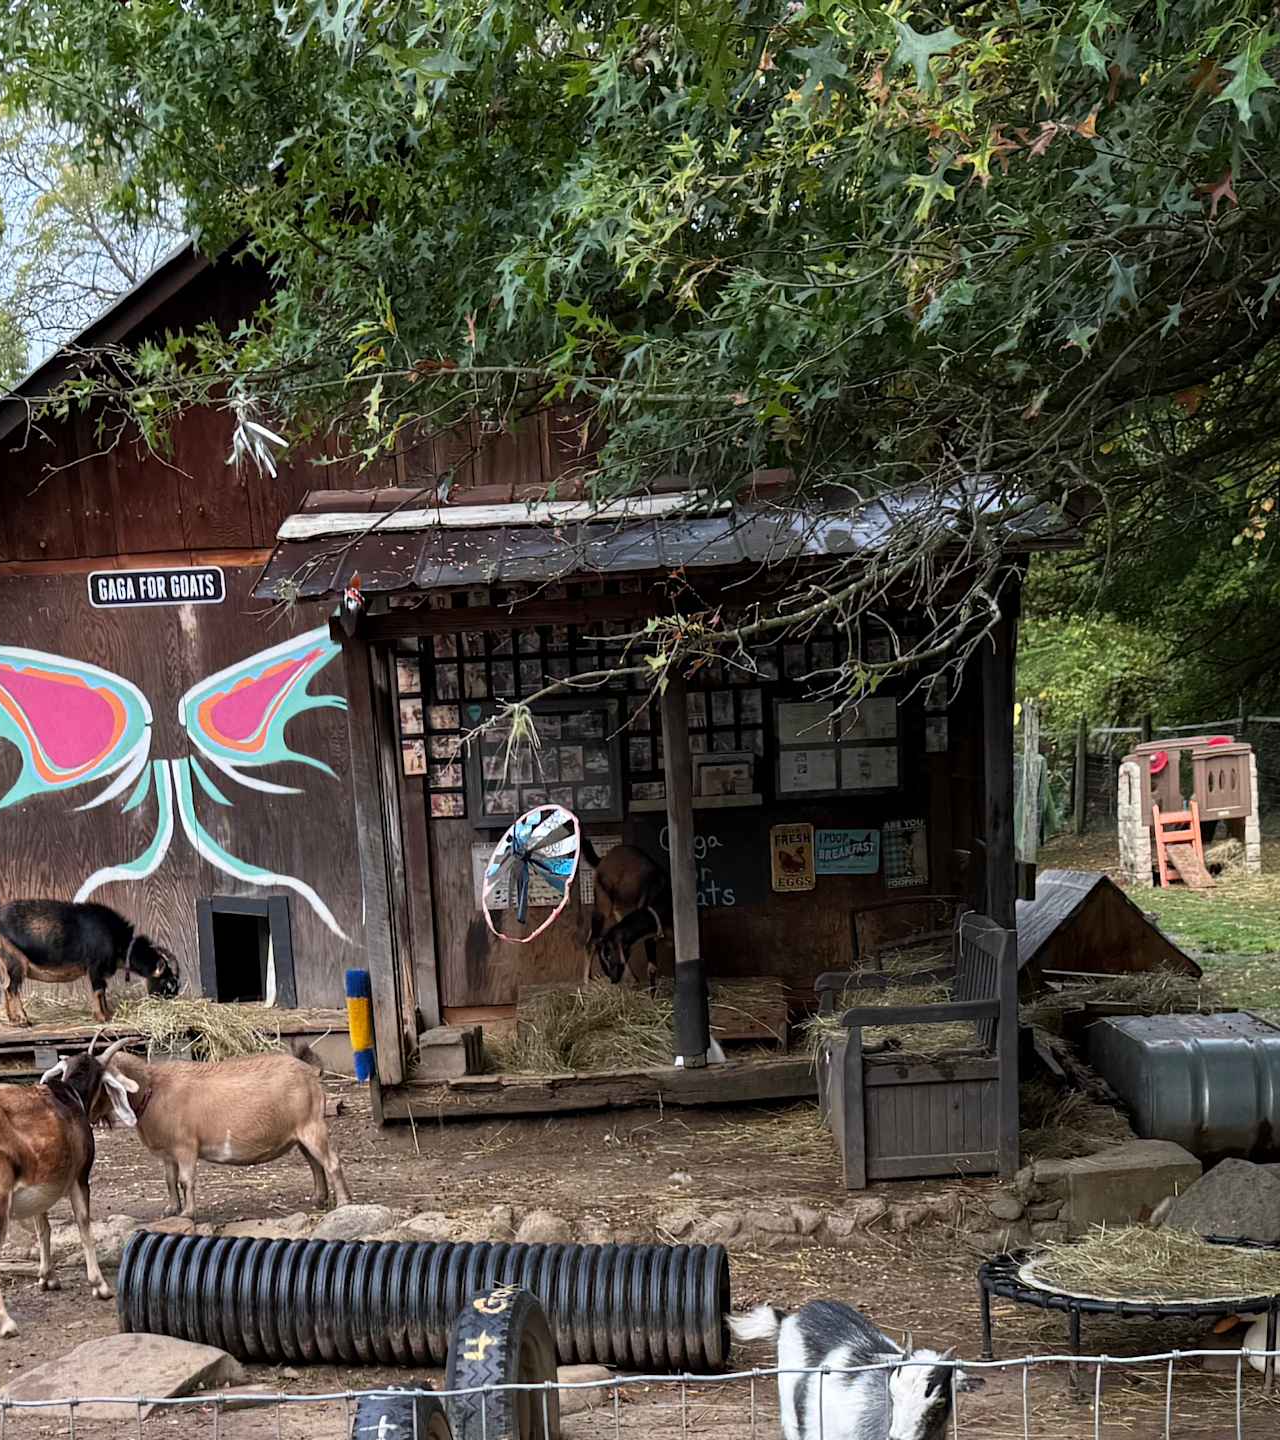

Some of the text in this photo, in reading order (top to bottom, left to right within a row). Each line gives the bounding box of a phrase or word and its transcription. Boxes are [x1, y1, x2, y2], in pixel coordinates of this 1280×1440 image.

[97, 574, 215, 601] GAGA FOR GOATS
[775, 832, 810, 847] FRESH
[776, 876, 811, 887] EGGS
